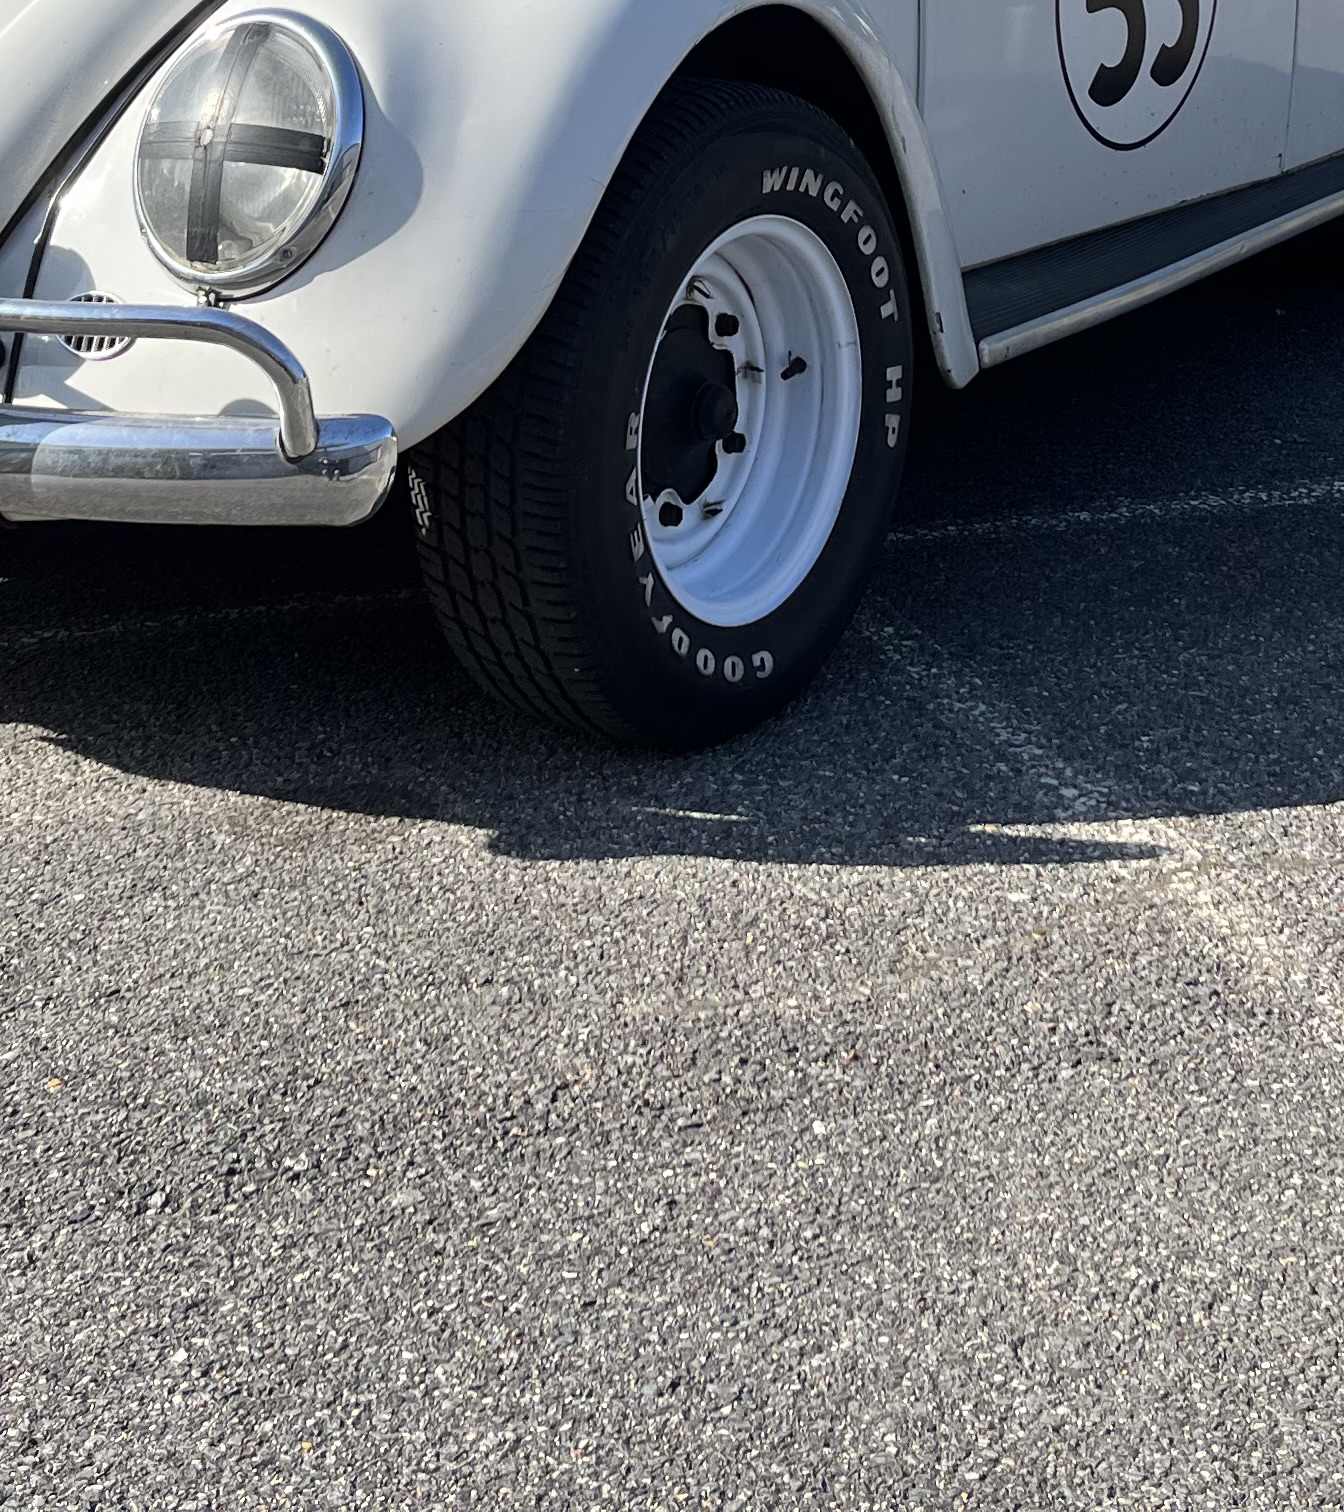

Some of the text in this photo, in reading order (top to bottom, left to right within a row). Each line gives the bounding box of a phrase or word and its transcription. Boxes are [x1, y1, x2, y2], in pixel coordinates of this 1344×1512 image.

[761, 166, 904, 449] WINGFOOT HP
[625, 410, 774, 683] GOODYEAR
